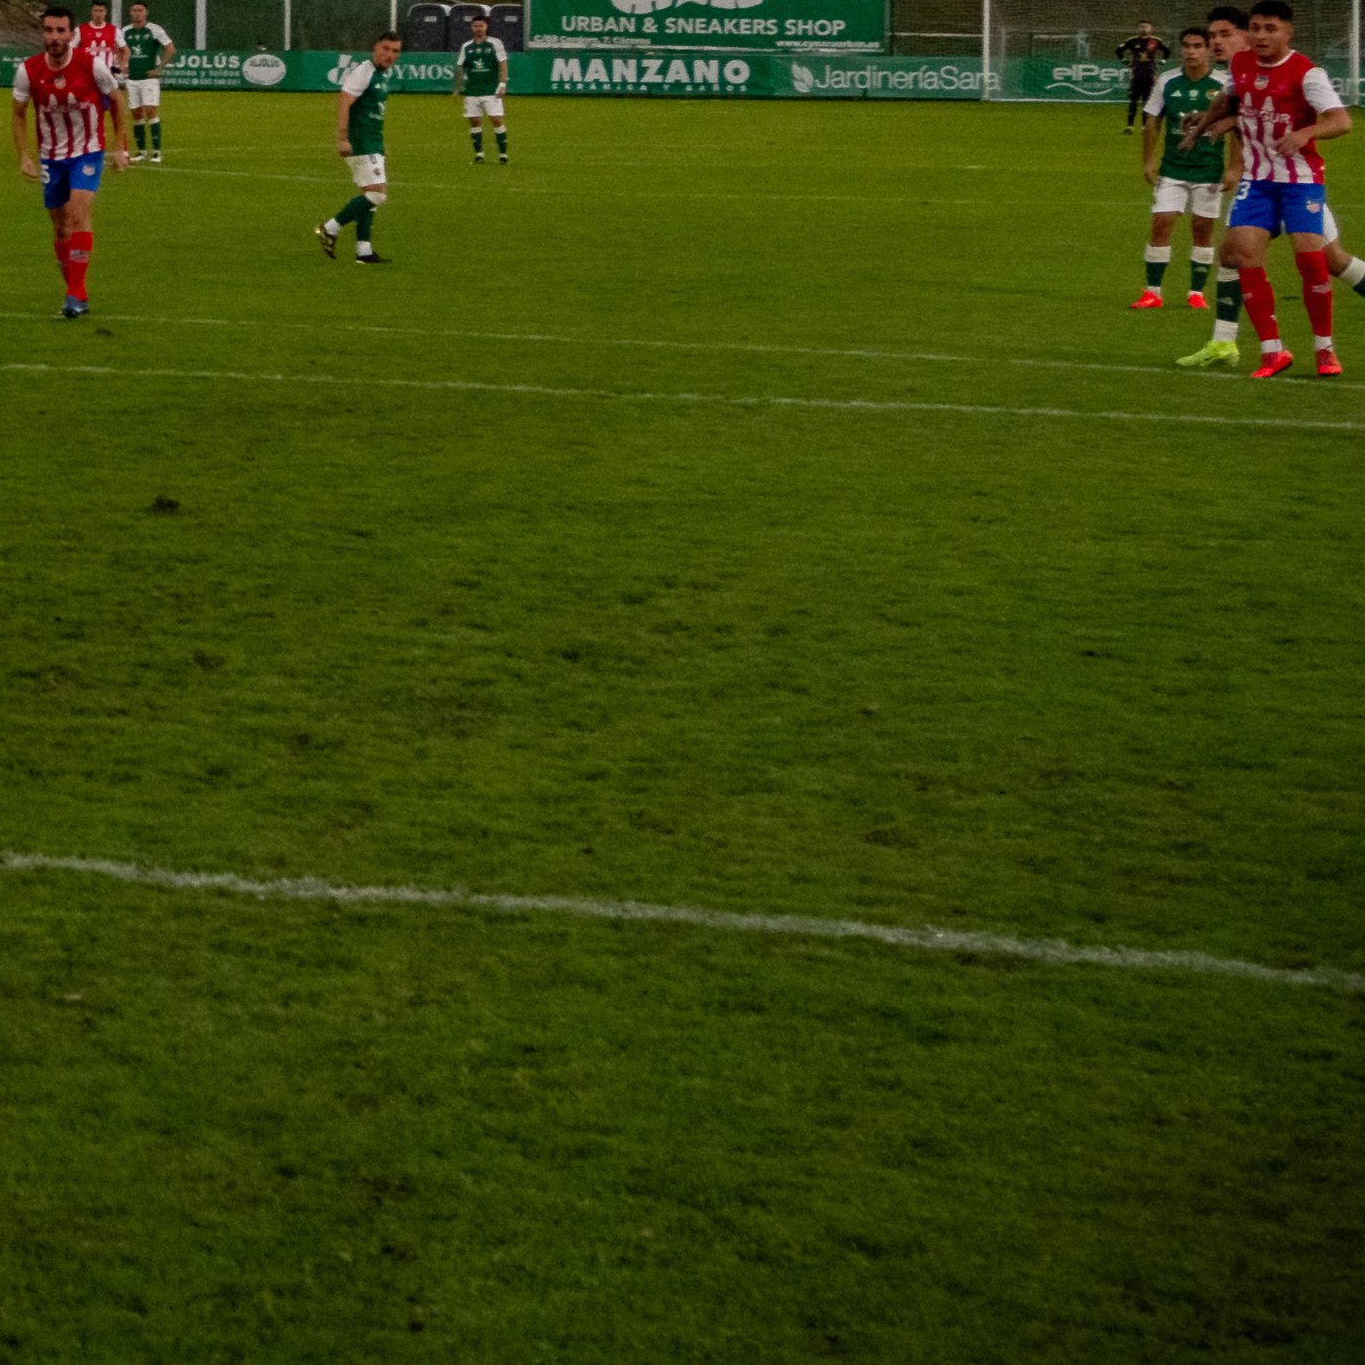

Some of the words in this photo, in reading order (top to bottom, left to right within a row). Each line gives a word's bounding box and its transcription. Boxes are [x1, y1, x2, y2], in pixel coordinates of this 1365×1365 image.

[562, 16, 636, 34] URBAN
[642, 18, 659, 34] &
[664, 18, 778, 36] SNEAKERS
[784, 20, 847, 37] SHOP
[551, 58, 751, 85] MANZANO
